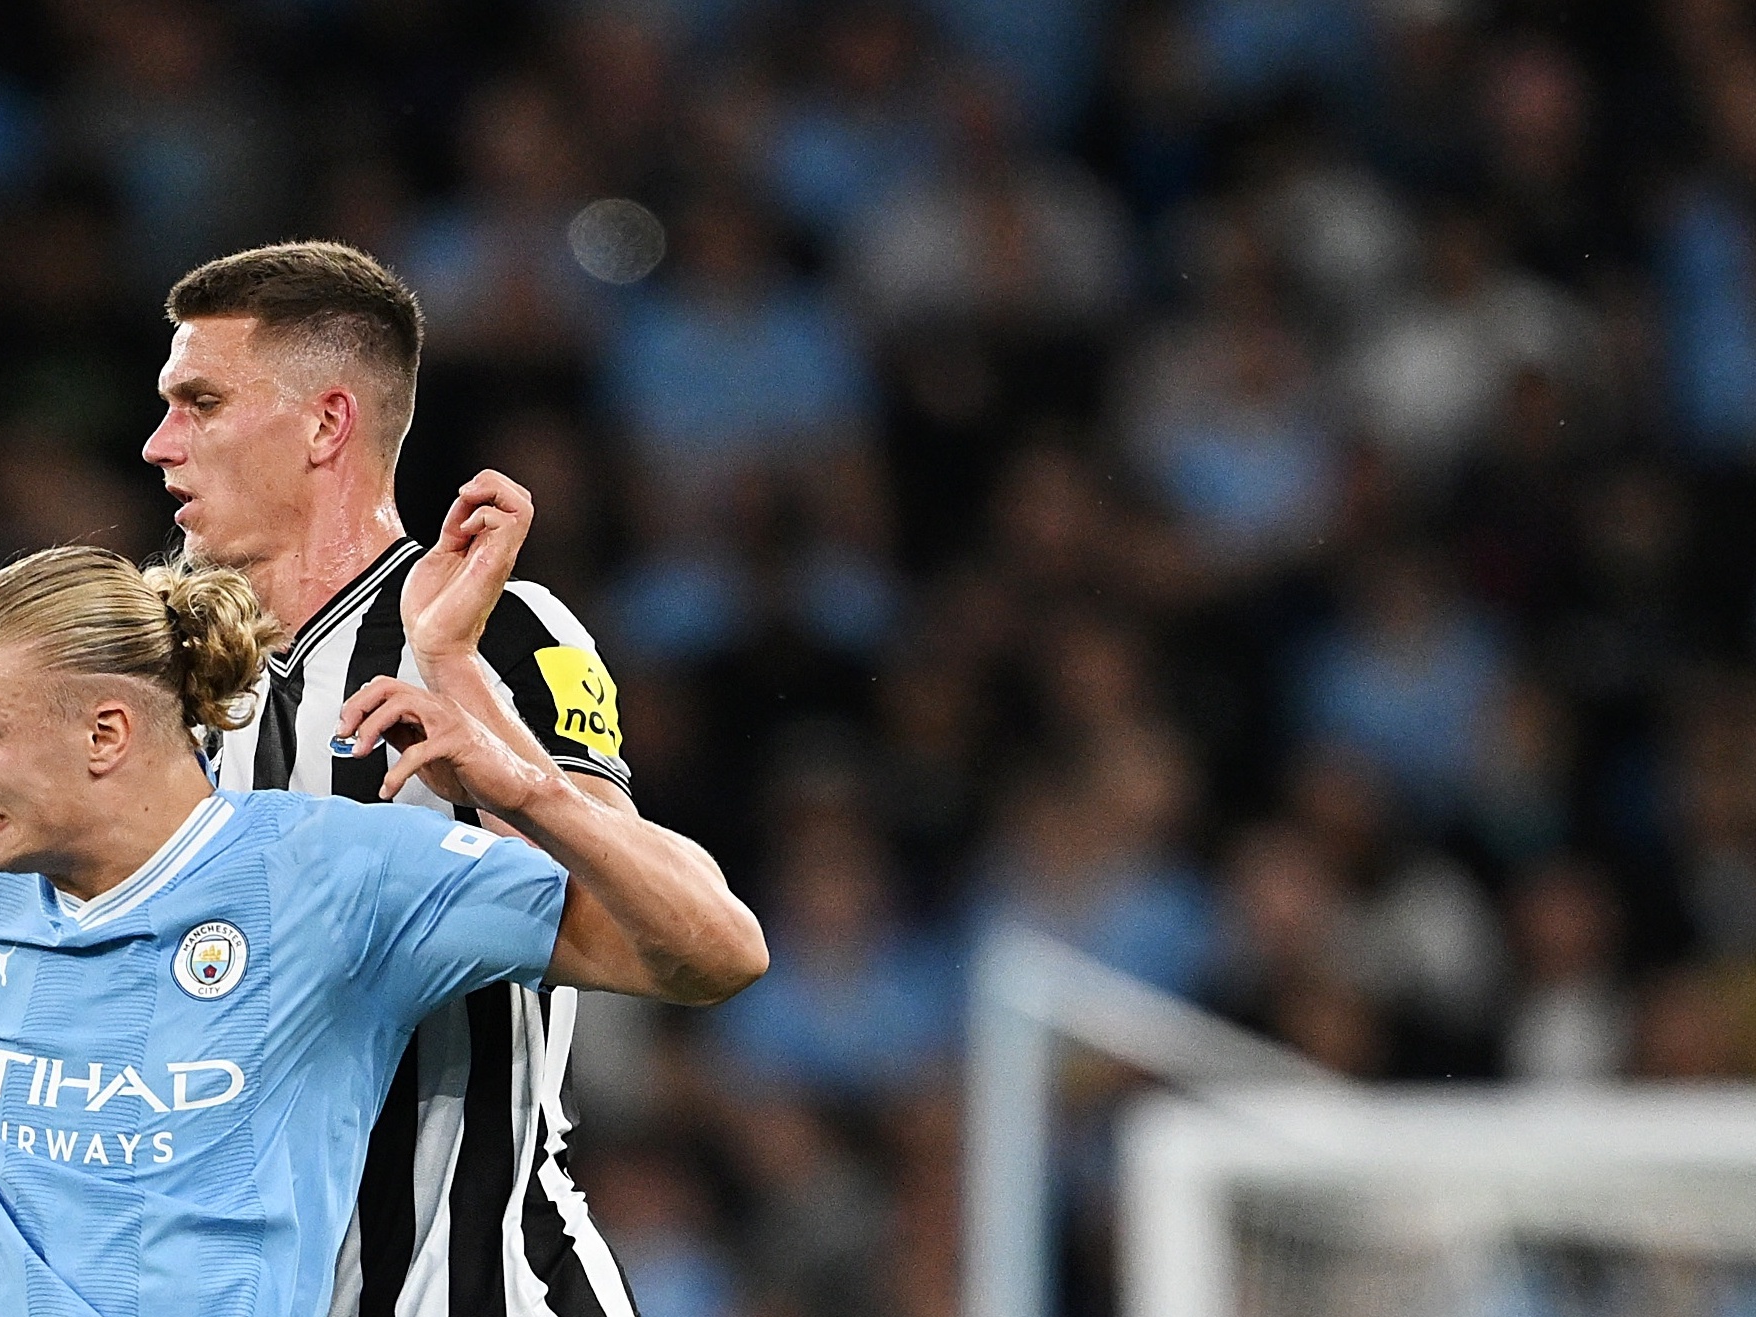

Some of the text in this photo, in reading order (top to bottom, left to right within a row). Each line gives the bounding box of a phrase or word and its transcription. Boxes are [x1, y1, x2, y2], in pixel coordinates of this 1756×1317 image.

[564, 708, 617, 749] no
[183, 925, 242, 952] MANCHESTER
[197, 987, 221, 995] CITY
